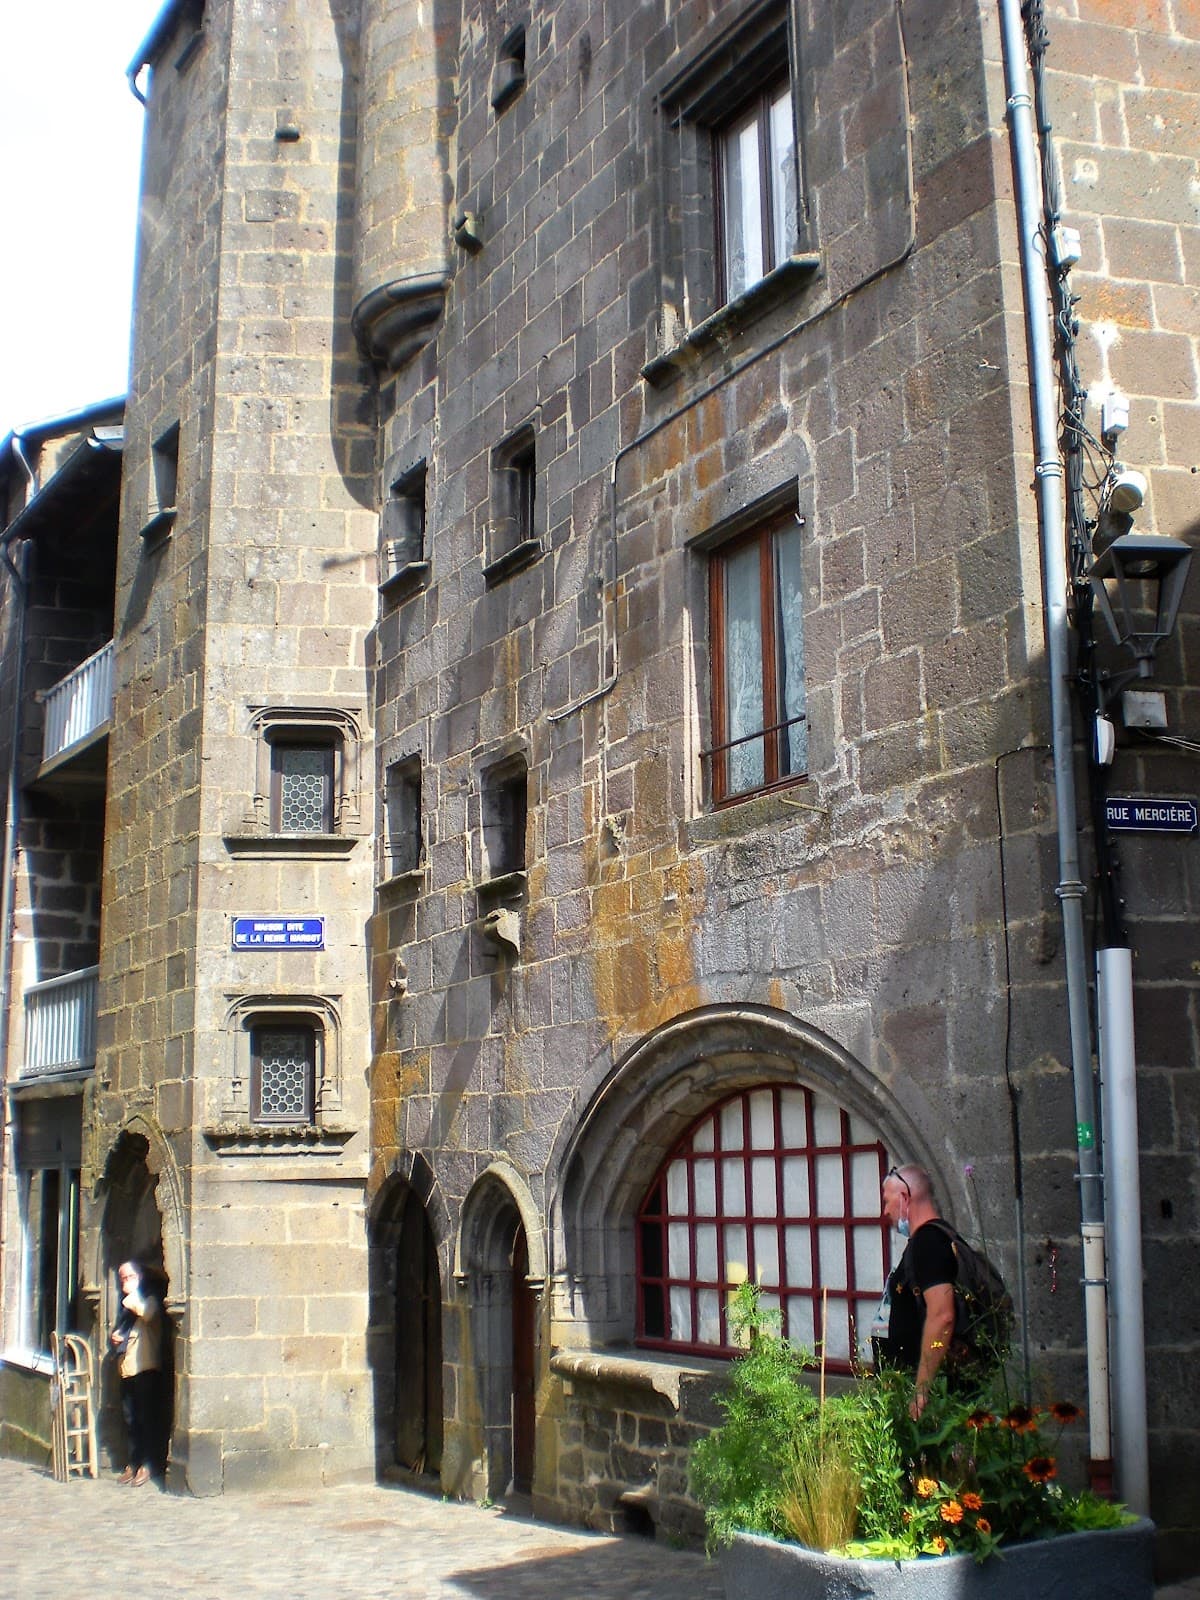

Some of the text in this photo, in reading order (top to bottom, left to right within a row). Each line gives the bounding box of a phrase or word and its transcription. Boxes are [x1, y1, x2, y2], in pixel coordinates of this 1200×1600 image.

[1106, 807, 1129, 820] RUE
[254, 923, 304, 931] MAISON DITE
[236, 934, 321, 942] DE LA REINE MARGOT
